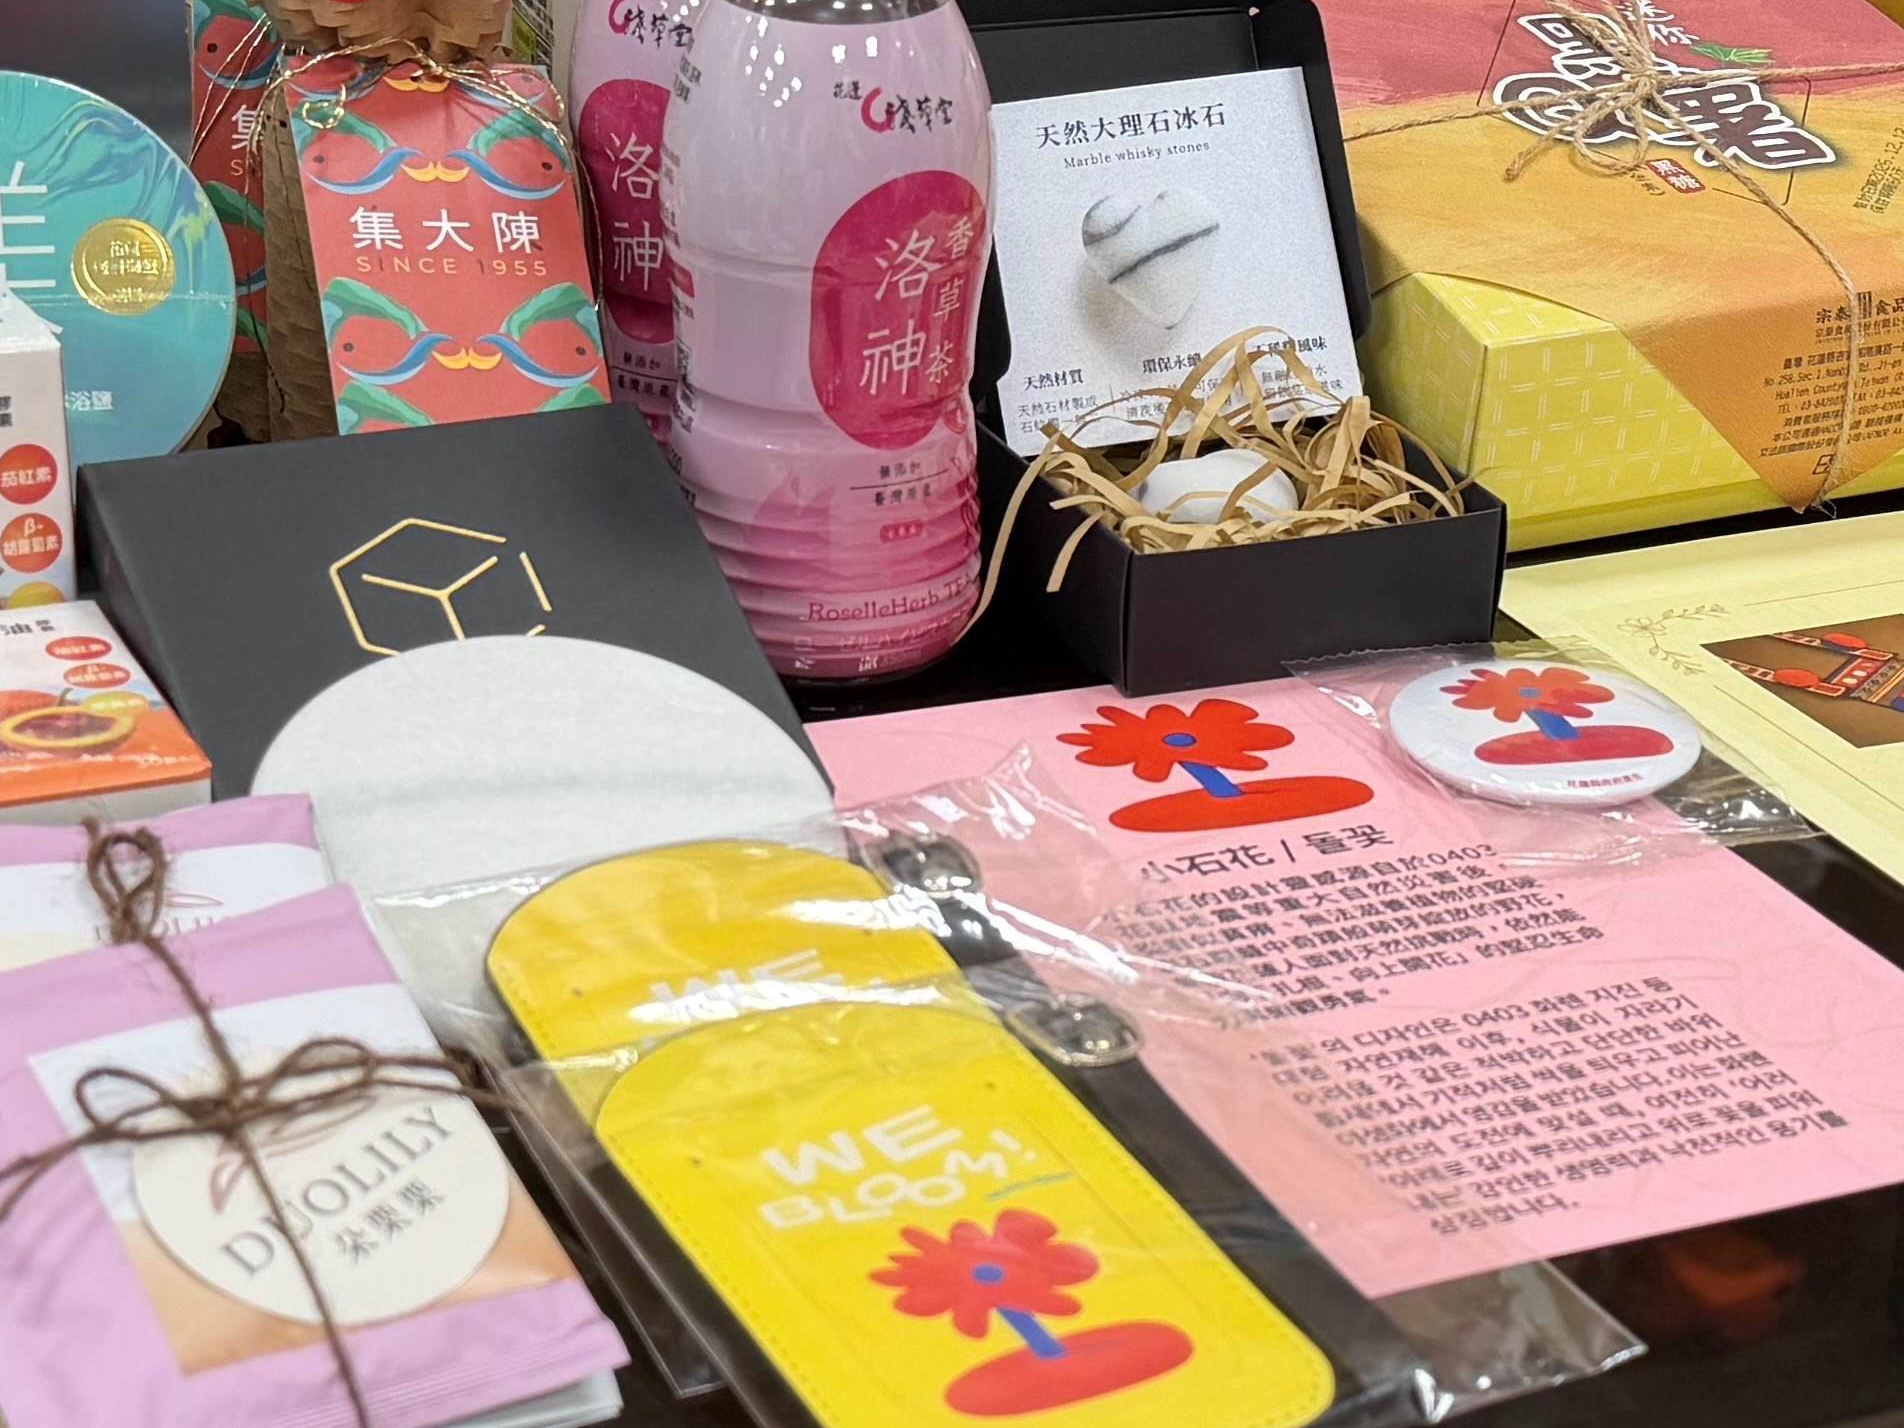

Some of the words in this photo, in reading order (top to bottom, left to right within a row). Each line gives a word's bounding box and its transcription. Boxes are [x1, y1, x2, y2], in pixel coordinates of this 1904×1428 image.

[1035, 102, 1228, 150] 天然大理石冰石
[1063, 152, 1112, 172] Marble
[1115, 145, 1165, 167] whisky
[1167, 139, 1211, 159] stones
[349, 207, 541, 256] 集大陳
[605, 130, 665, 294] 洛神
[356, 257, 459, 277] SINCE
[479, 257, 548, 278] 1955
[859, 226, 942, 396] 洛神
[925, 215, 974, 385] 香草茶
[1023, 368, 1084, 392] 天然材質
[807, 591, 940, 622] RoselleHerb
[1302, 824, 1392, 854] 돌꽃
[1461, 1004, 1530, 1026] 0403
[1585, 982, 1643, 1002] 지진
[1614, 993, 1698, 1019] 자라기
[759, 1104, 964, 1189] WE
[758, 1132, 1039, 1233] BLOOM!
